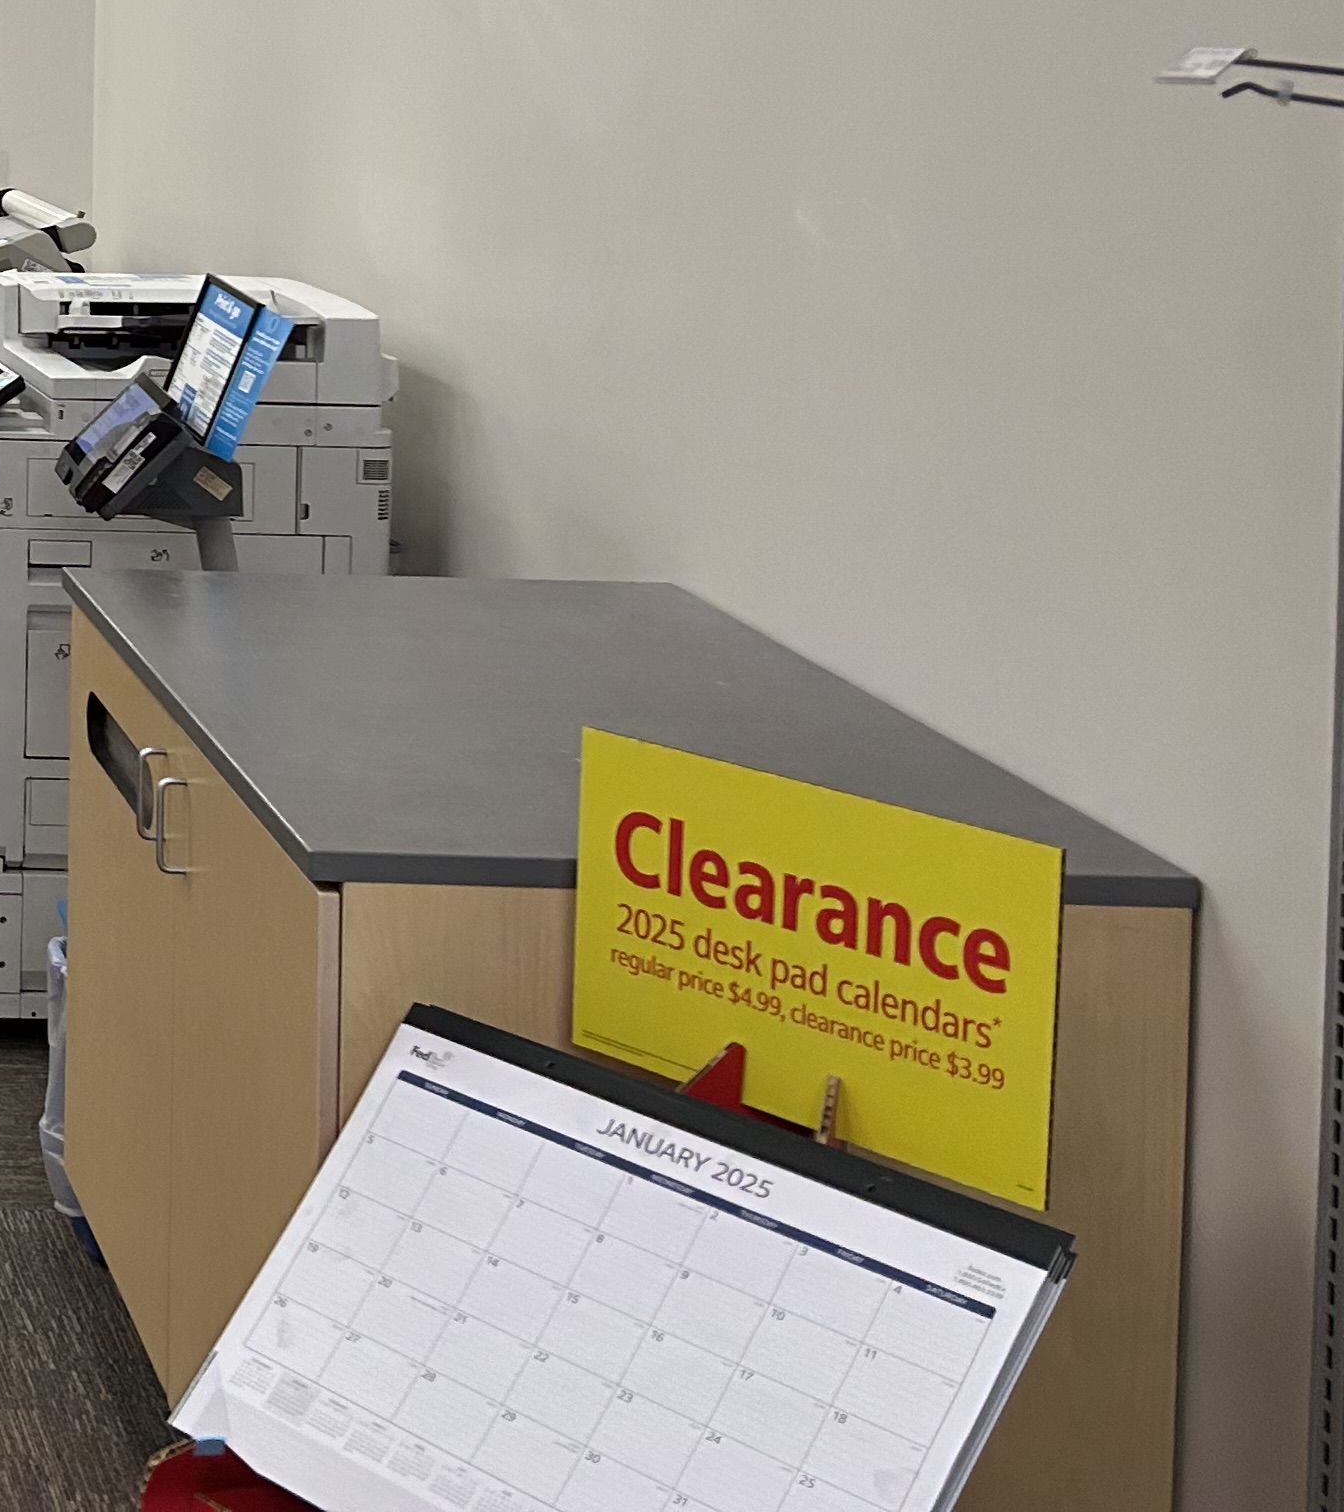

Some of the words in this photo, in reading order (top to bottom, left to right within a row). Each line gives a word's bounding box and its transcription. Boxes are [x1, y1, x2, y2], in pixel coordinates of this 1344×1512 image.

[614, 811, 1011, 995] Clearance
[616, 903, 685, 951] 2025
[694, 928, 762, 977] desk
[771, 956, 828, 997] pad
[611, 946, 673, 980] regular
[678, 969, 724, 999] price
[728, 982, 785, 1022] $4.99,
[790, 1002, 885, 1051] clearance
[889, 1042, 941, 1072] price
[946, 1050, 1006, 1090] $3.99
[596, 1118, 711, 1172] JANUARY
[711, 1162, 775, 1199] 2025
[567, 1291, 580, 1305] 15
[652, 1330, 665, 1343] 16
[740, 1369, 755, 1381] 17
[833, 1410, 849, 1425] 18
[771, 1308, 786, 1322] 10
[864, 1347, 878, 1361] 11
[533, 1349, 550, 1363] 22
[617, 1390, 634, 1404] 23
[799, 1474, 816, 1489] 25
[584, 1450, 601, 1464] 30
[672, 1494, 688, 1508] 31
